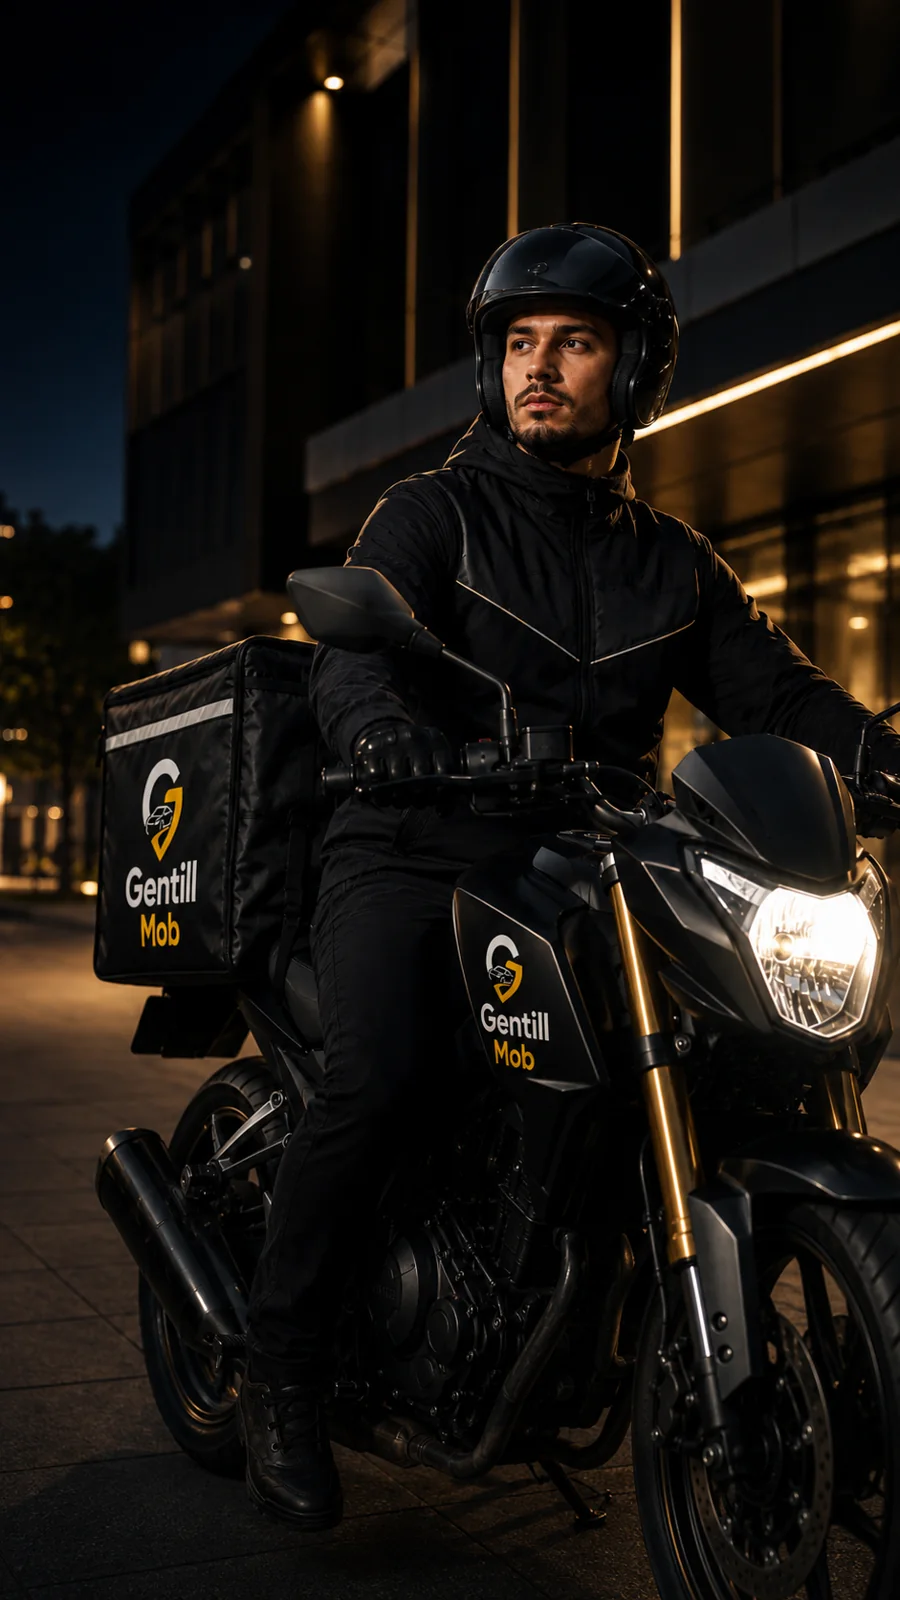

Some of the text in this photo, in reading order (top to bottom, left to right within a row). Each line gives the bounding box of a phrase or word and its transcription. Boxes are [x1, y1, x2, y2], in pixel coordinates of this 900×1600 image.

[125, 860, 198, 908] Gentill
[140, 911, 180, 948] Mob
[480, 1002, 550, 1041] Gentill
[493, 1038, 536, 1071] Mob
